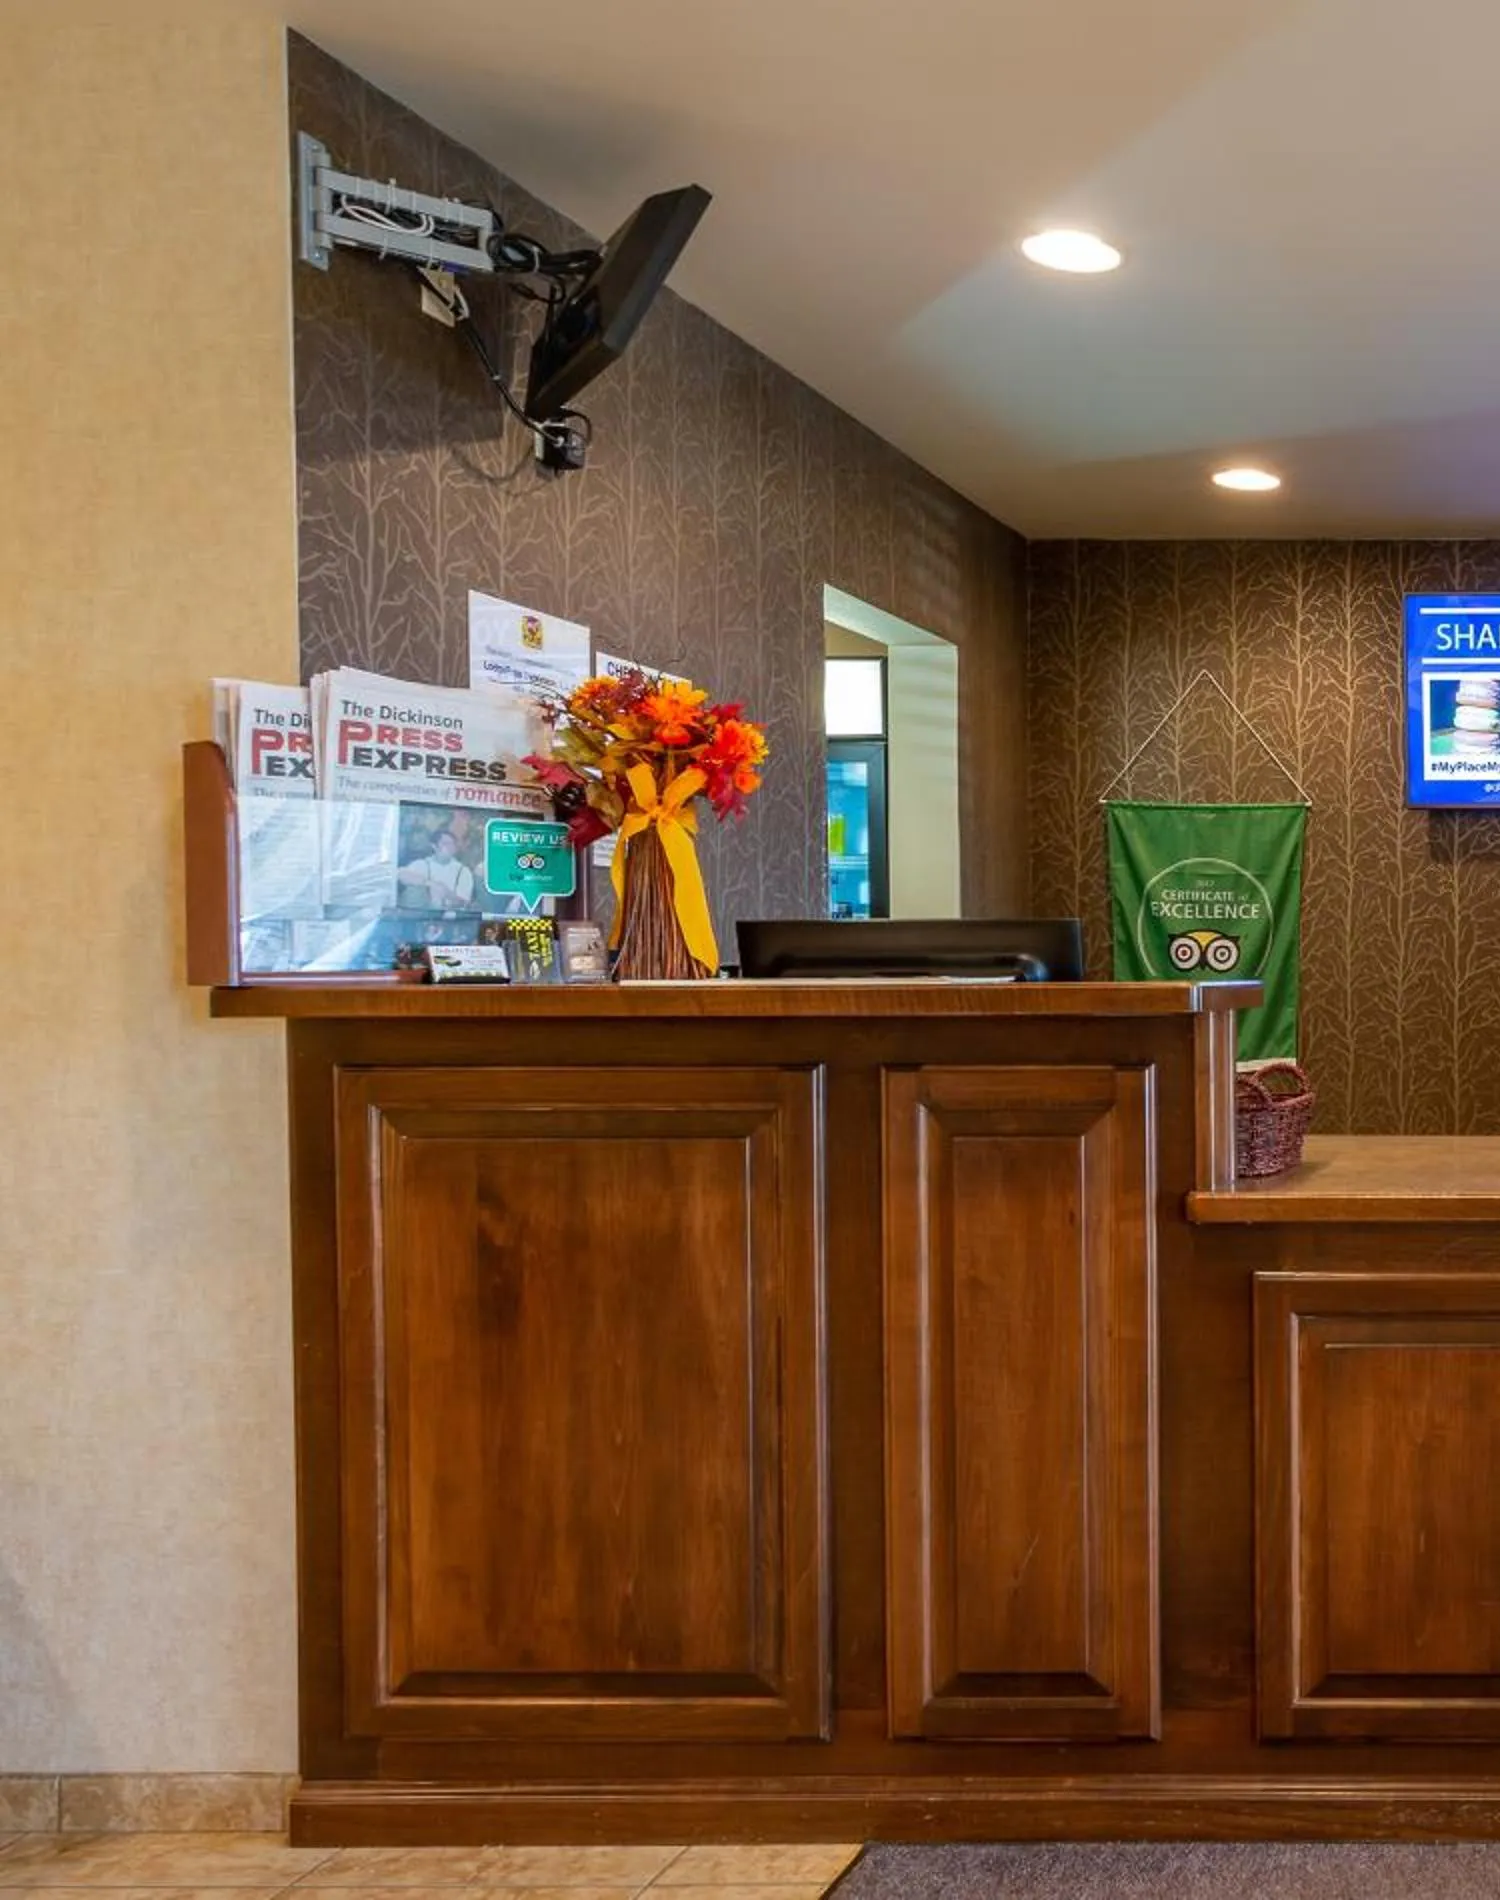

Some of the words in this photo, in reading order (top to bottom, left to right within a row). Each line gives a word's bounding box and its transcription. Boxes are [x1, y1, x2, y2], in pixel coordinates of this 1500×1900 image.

[254, 708, 284, 726] The
[341, 700, 374, 718] The
[379, 705, 463, 729] Dickinson
[338, 719, 463, 766] PRESS
[352, 747, 507, 780] EXPRESS
[455, 785, 543, 808] romance
[492, 831, 545, 843] REVIEW
[1161, 889, 1235, 901] CERTIFICATE
[1151, 901, 1261, 919] EXCELLENCE
